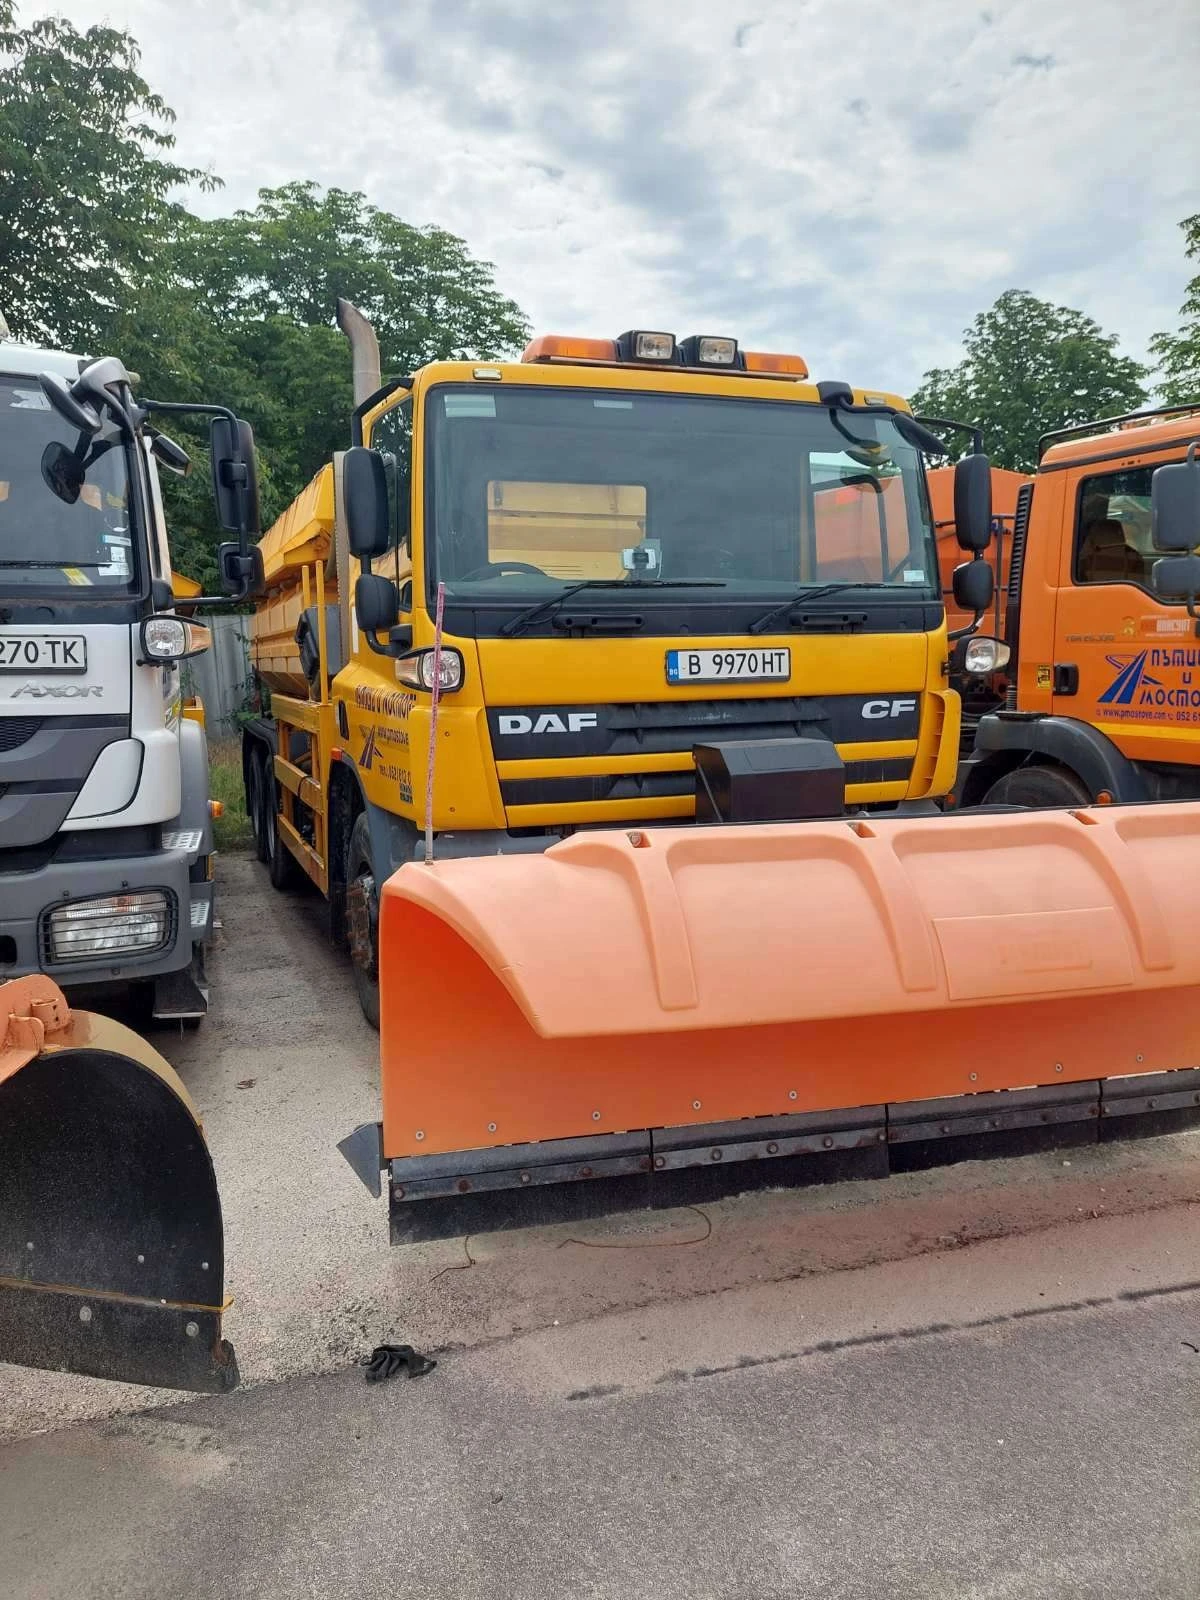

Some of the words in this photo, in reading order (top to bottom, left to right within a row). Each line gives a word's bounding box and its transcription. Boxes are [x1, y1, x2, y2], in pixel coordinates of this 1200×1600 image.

[45, 641, 79, 664] TK
[1151, 649, 1200, 666] Пъти
[688, 654, 701, 675] B
[712, 653, 758, 674] 9970
[762, 653, 785, 673] HT
[862, 700, 916, 719] CF
[1176, 711, 1190, 721] 052
[499, 713, 597, 735] DAF
